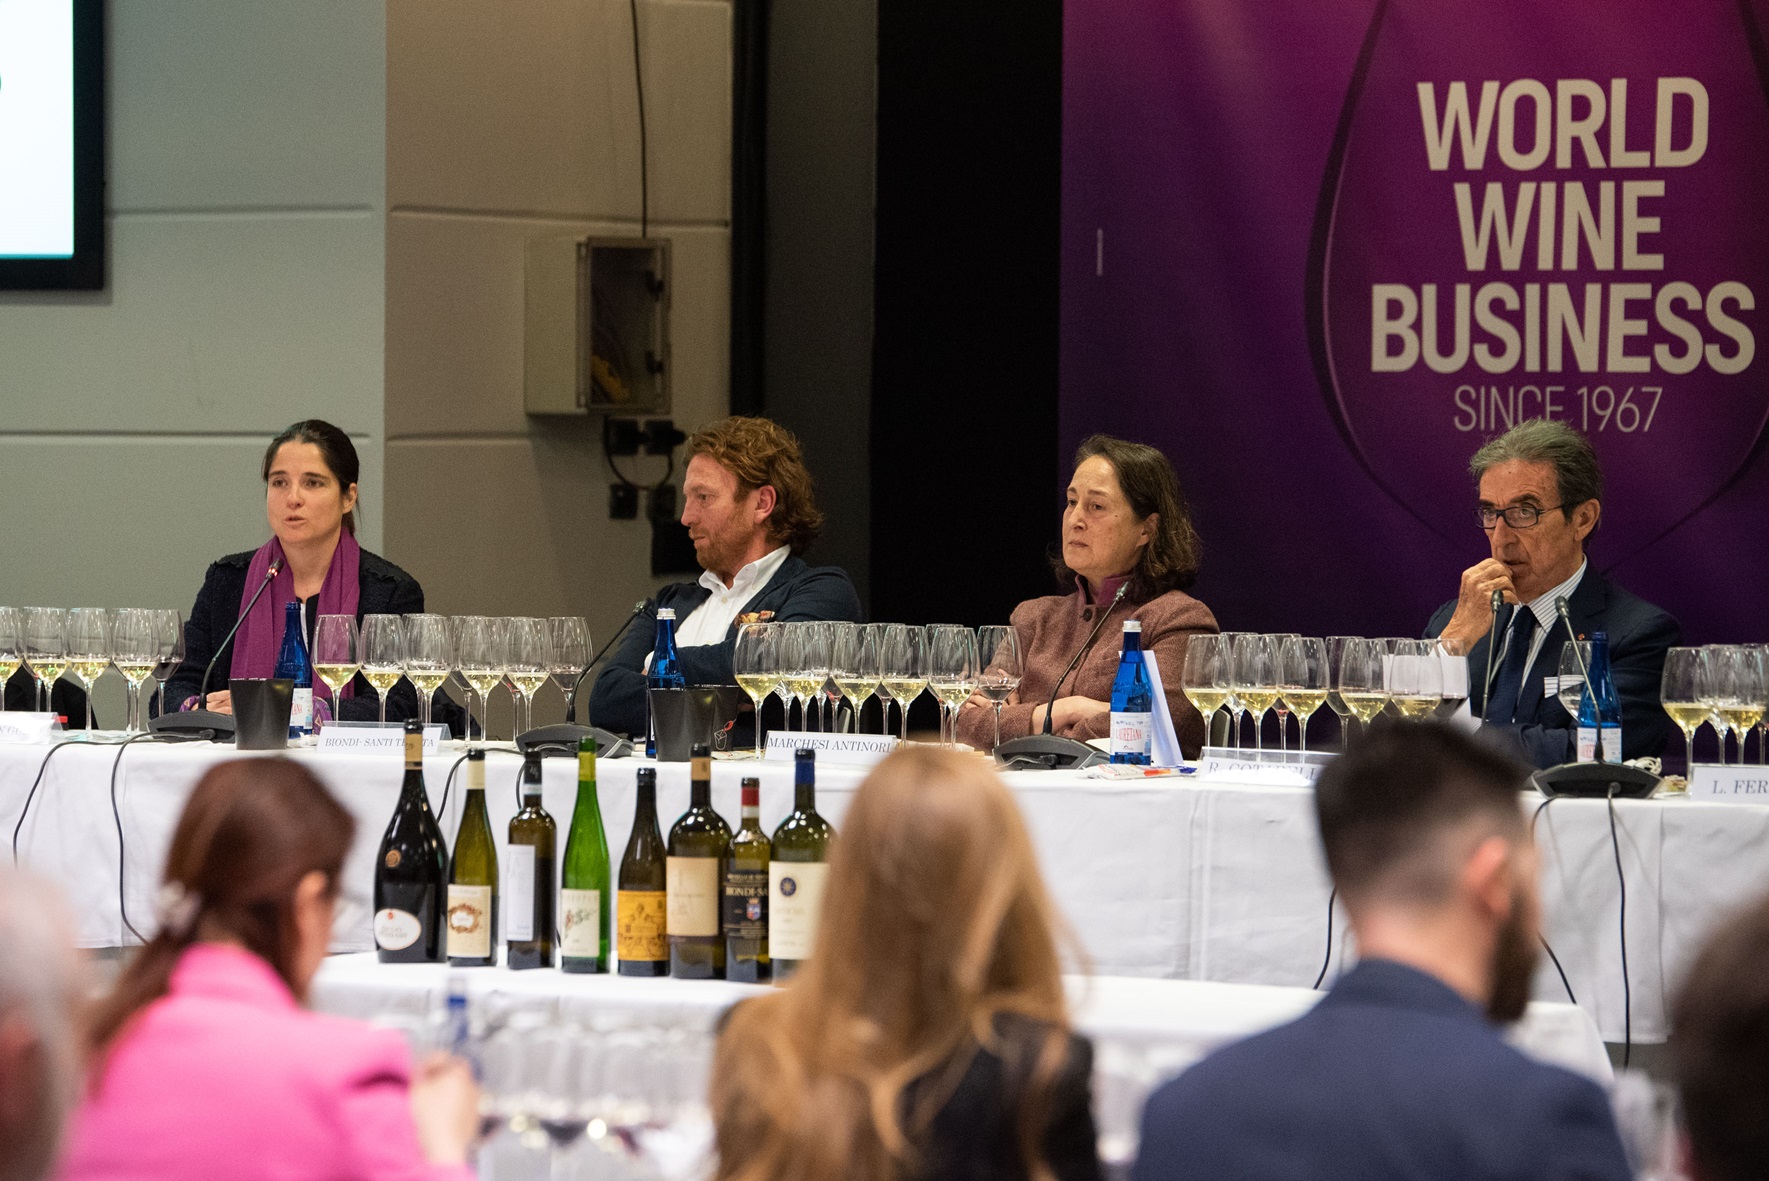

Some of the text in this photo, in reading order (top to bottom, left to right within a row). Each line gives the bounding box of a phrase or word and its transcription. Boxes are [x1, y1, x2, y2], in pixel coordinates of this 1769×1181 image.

[1416, 76, 1710, 171] WORLD
[1453, 179, 1666, 271] WINE
[1370, 281, 1756, 375] BUSINESS
[1453, 384, 1663, 433] SINCE 1967
[363, 738, 393, 747] SANTI
[767, 737, 892, 753] MARCHESI ANTINORI
[1712, 780, 1727, 794] L.
